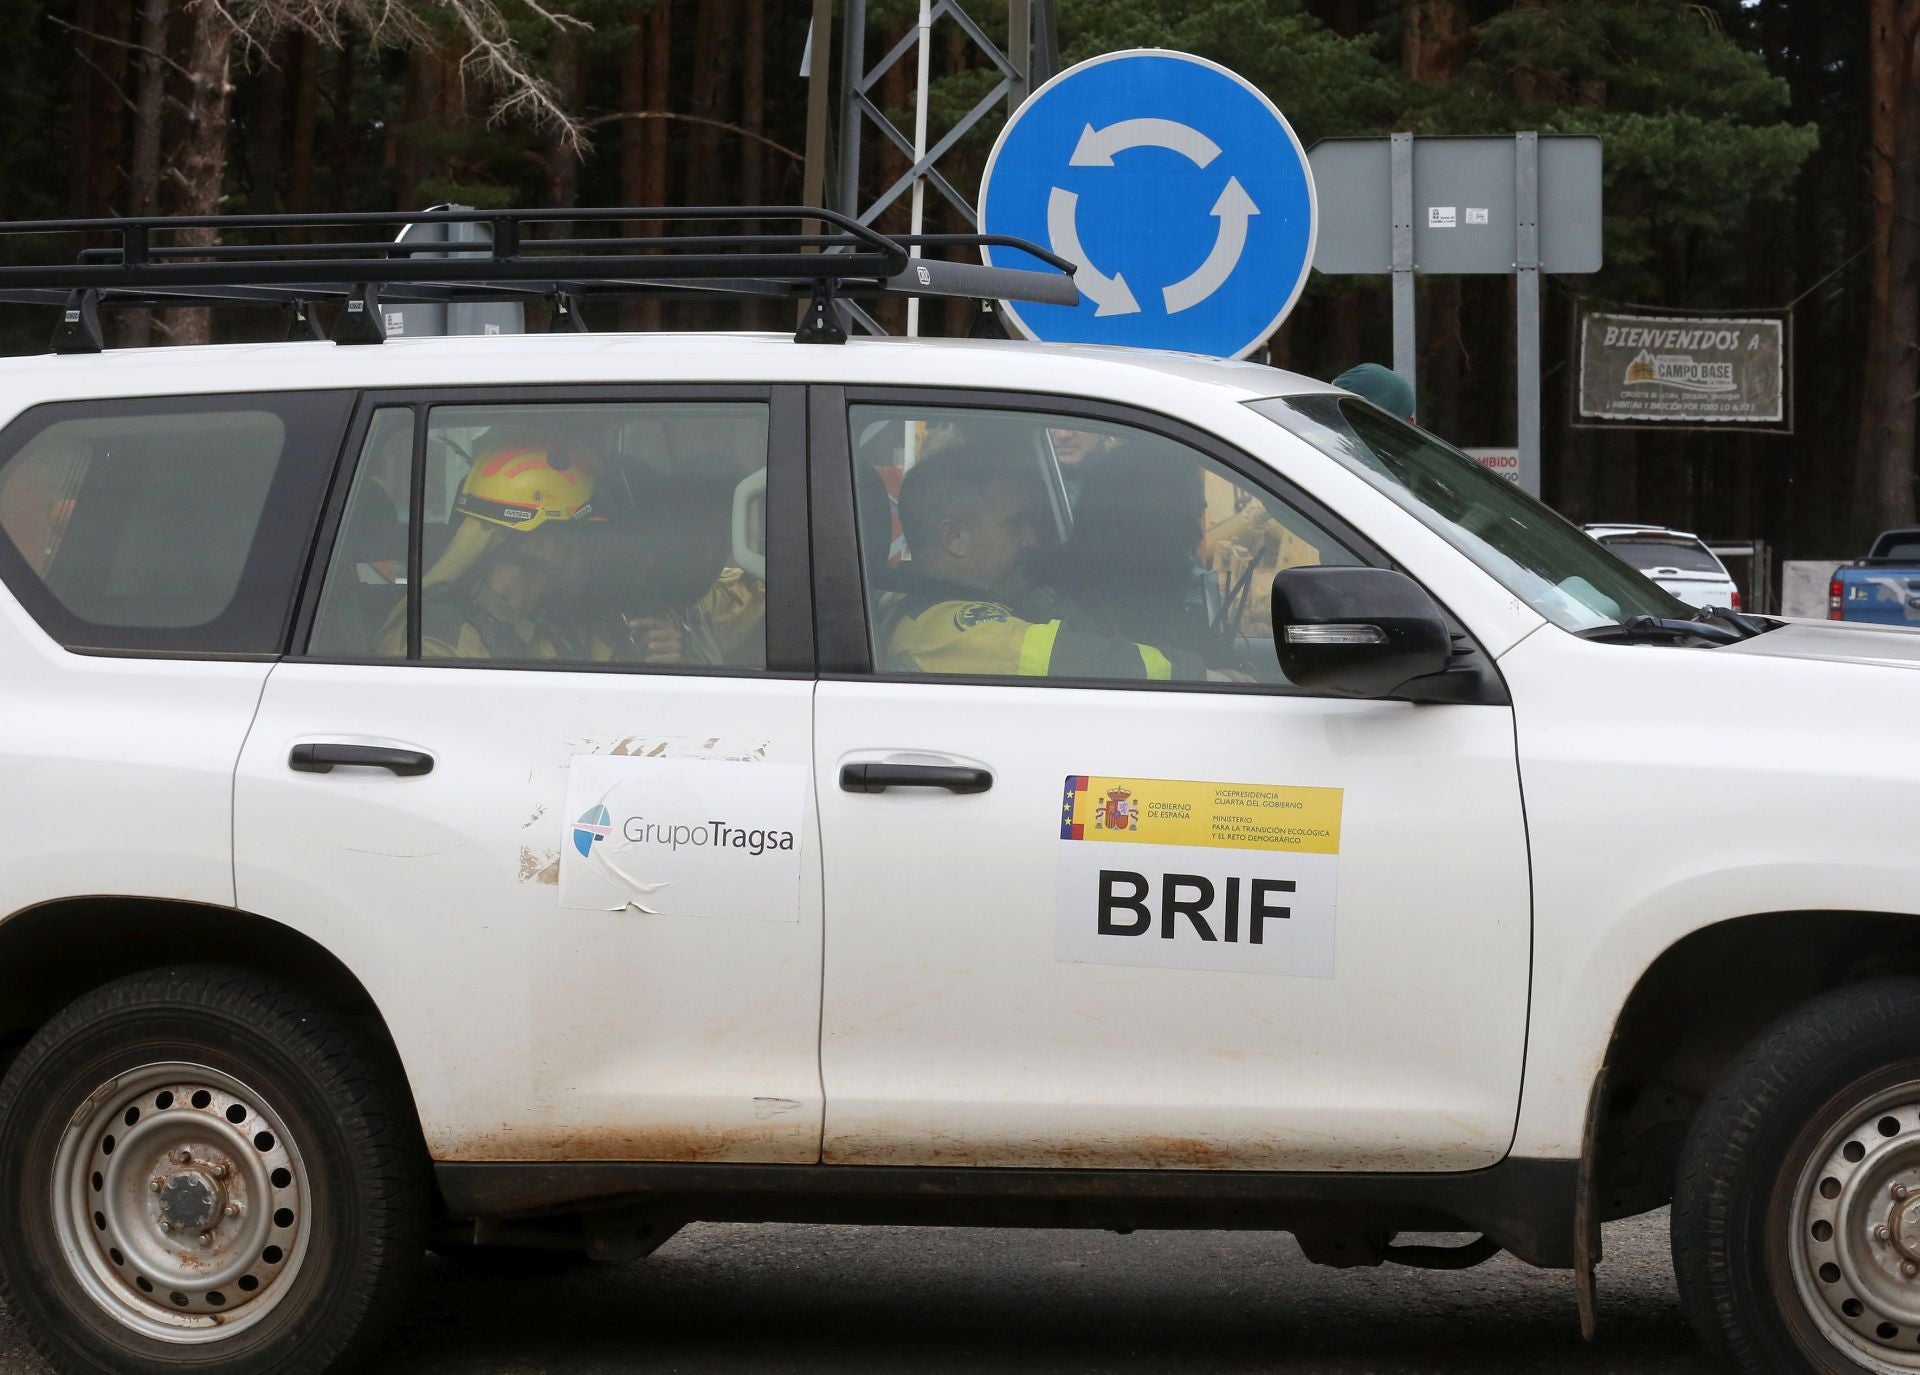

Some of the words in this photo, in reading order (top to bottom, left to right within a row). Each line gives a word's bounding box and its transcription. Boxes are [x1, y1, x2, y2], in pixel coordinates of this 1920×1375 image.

[1603, 326, 1740, 351] BIENVENIDOS
[1748, 333, 1760, 350] A
[1658, 364, 1698, 378] CAMPO
[1701, 364, 1730, 378] BASE
[1477, 457, 1517, 467] HIBIDO
[1215, 790, 1279, 799] VICEPRESIDENCIA
[1148, 802, 1192, 811] GOBIERNO
[1214, 798, 1245, 806] CUARTA
[1262, 801, 1303, 809] GOBIERNO
[1147, 810, 1159, 818] DE
[1160, 810, 1190, 819] ESPAÑA
[1212, 815, 1253, 824] MINISTERIO
[623, 816, 795, 855] GrupoTragsa
[1212, 823, 1230, 832] PARA
[1231, 824, 1241, 832] LA
[1242, 825, 1286, 835] TRANSICIÓN
[1287, 827, 1330, 837] ECOLÓGICA
[1227, 833, 1246, 841] RETO
[1247, 834, 1301, 844] DEMOGRÁFICO
[1098, 869, 1297, 945] BRIF
